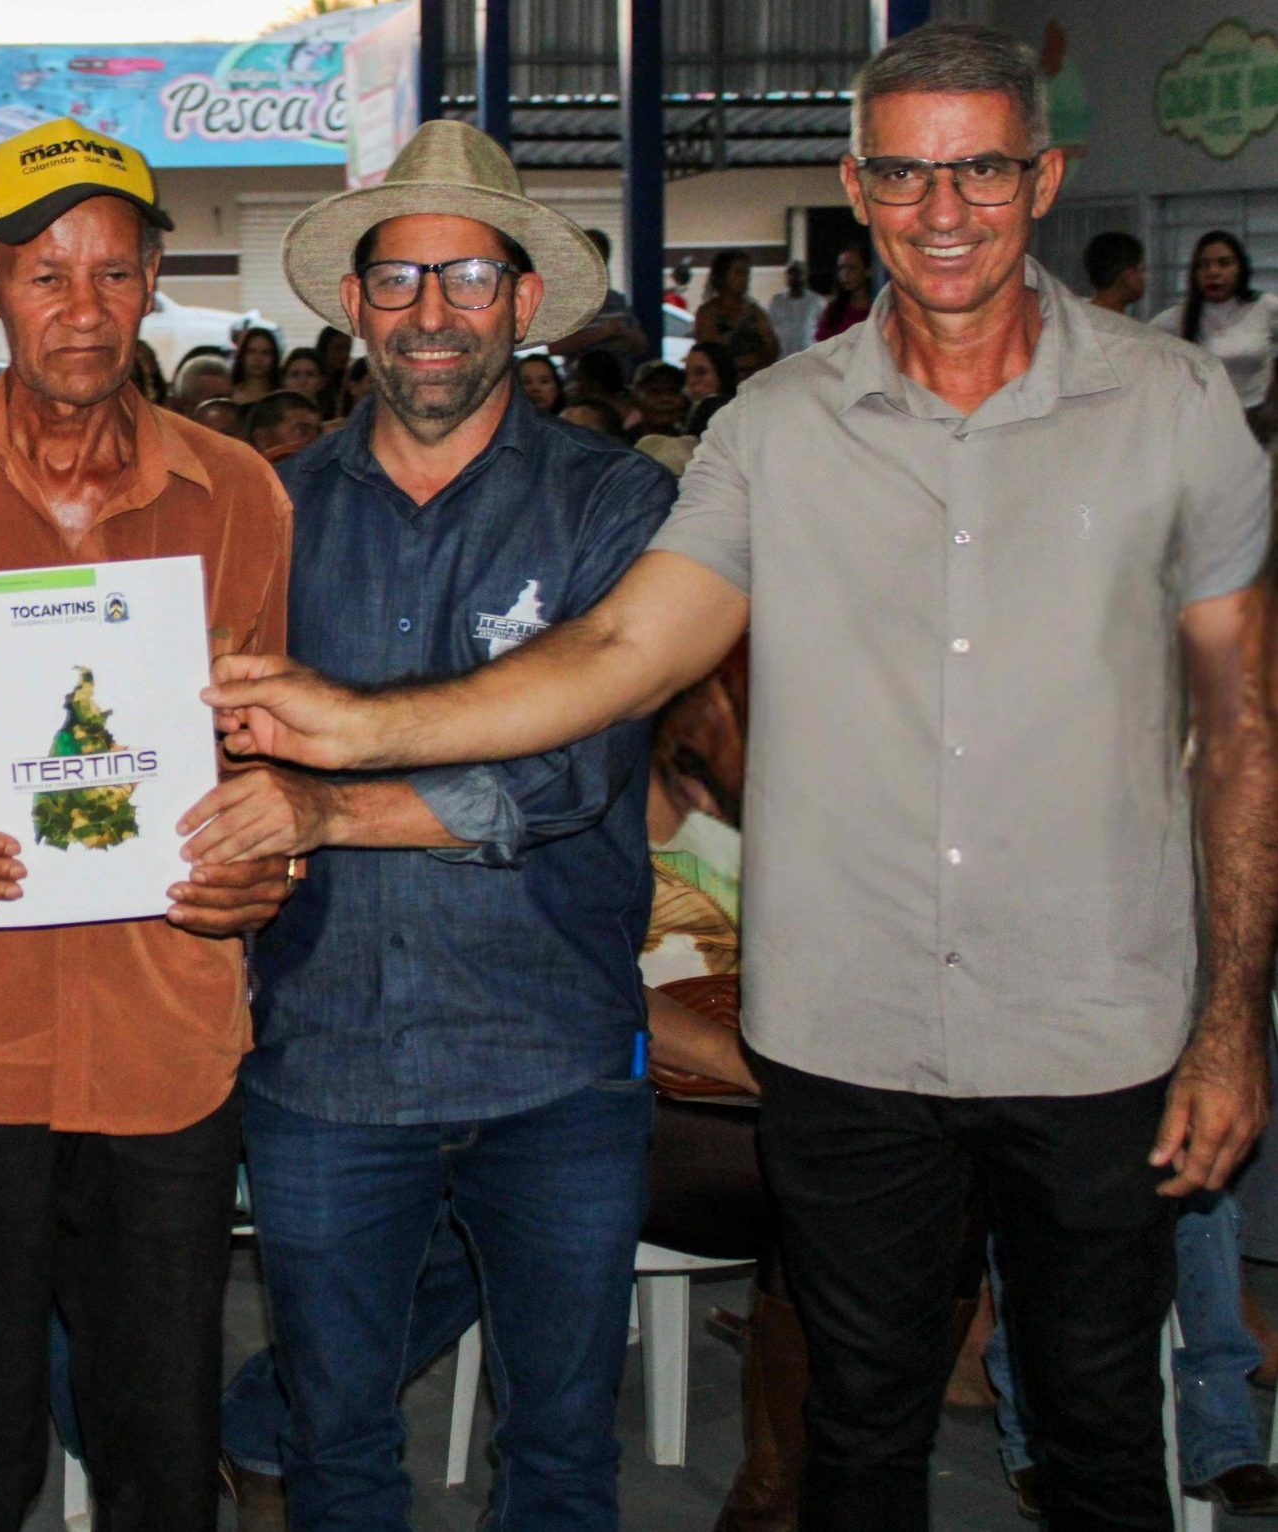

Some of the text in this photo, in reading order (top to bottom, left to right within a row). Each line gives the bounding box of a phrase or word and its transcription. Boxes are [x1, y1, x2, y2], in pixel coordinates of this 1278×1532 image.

[168, 82, 310, 134] Pesca
[22, 156, 76, 175] Colorindo
[10, 600, 96, 619] TOCANTINS
[11, 751, 158, 784] ITERTINS
